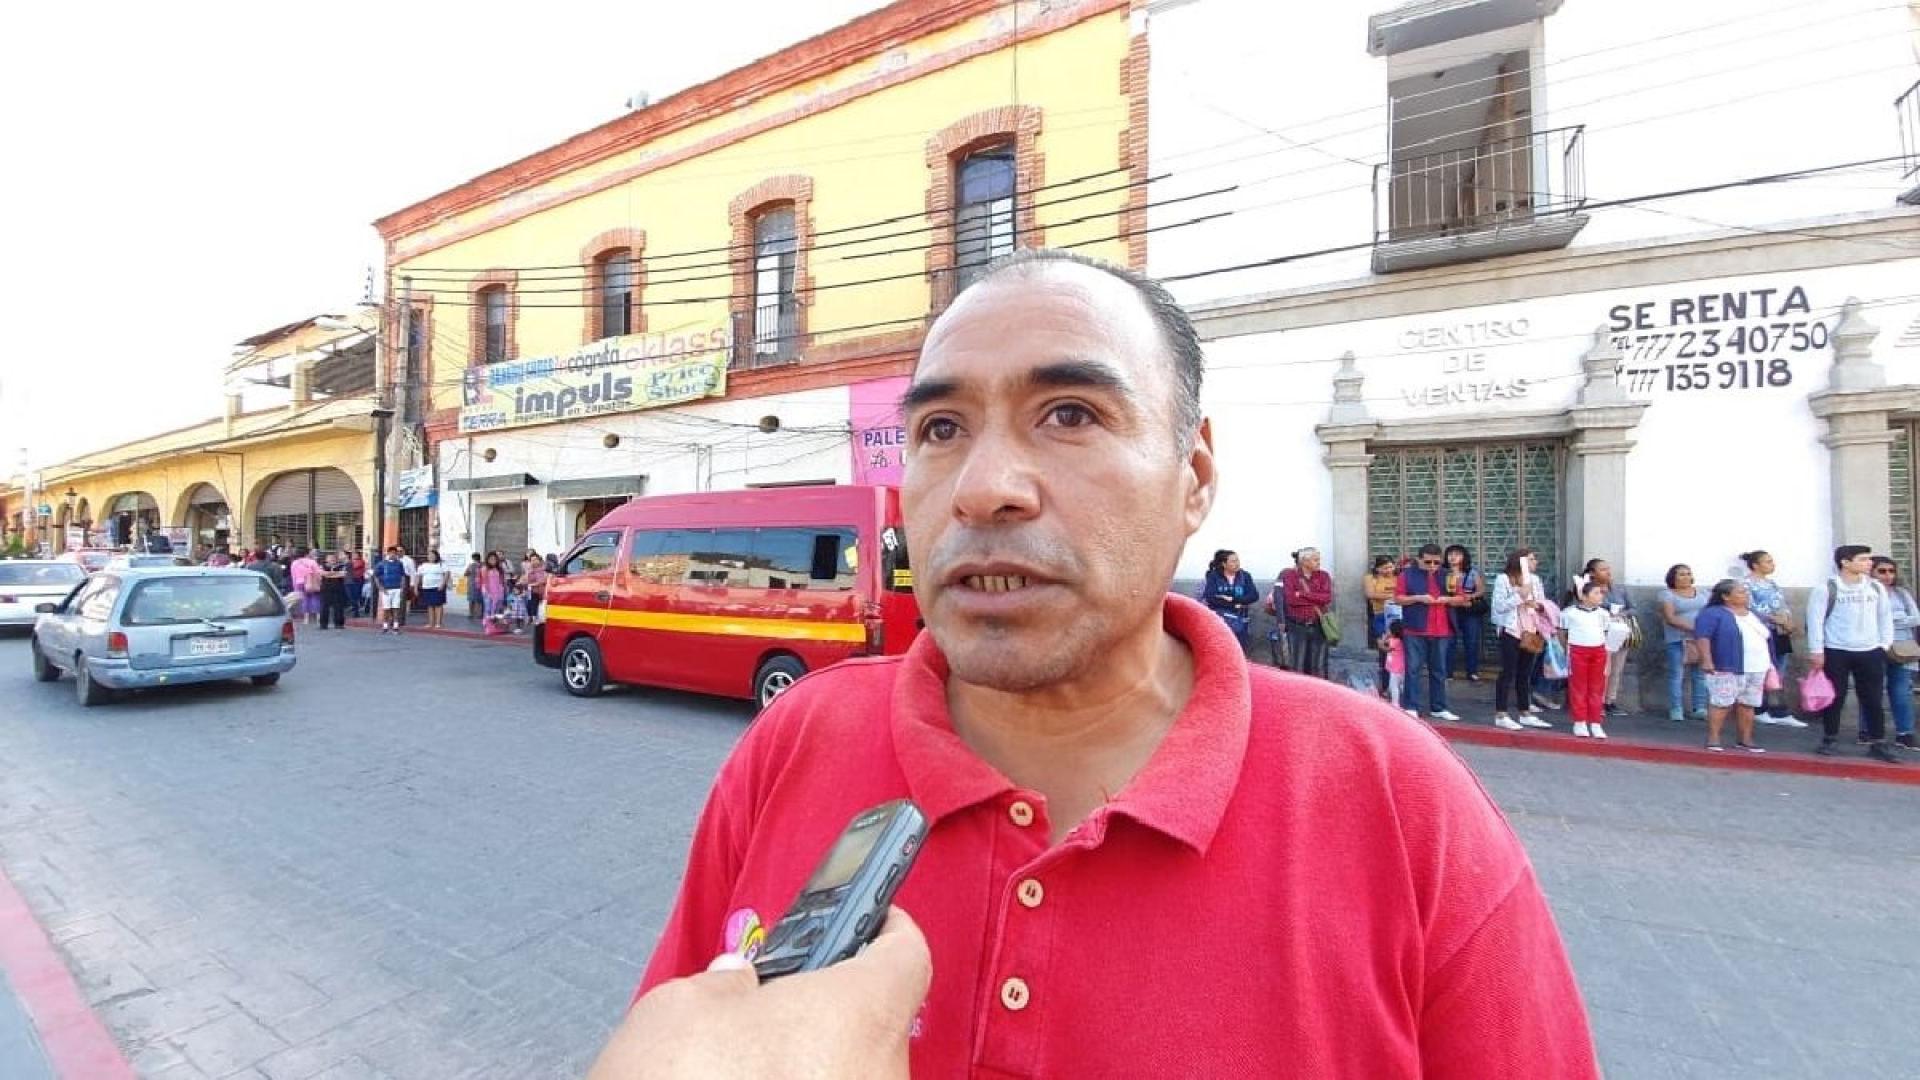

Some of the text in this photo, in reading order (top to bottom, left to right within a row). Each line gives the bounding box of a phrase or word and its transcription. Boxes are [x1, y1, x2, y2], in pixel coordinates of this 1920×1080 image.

[1608, 285, 1811, 332] SE RENTA
[1398, 318, 1530, 350] CENTRO
[1442, 352, 1486, 374] DE
[515, 371, 633, 418] impuls
[1400, 378, 1530, 406] VENTAS
